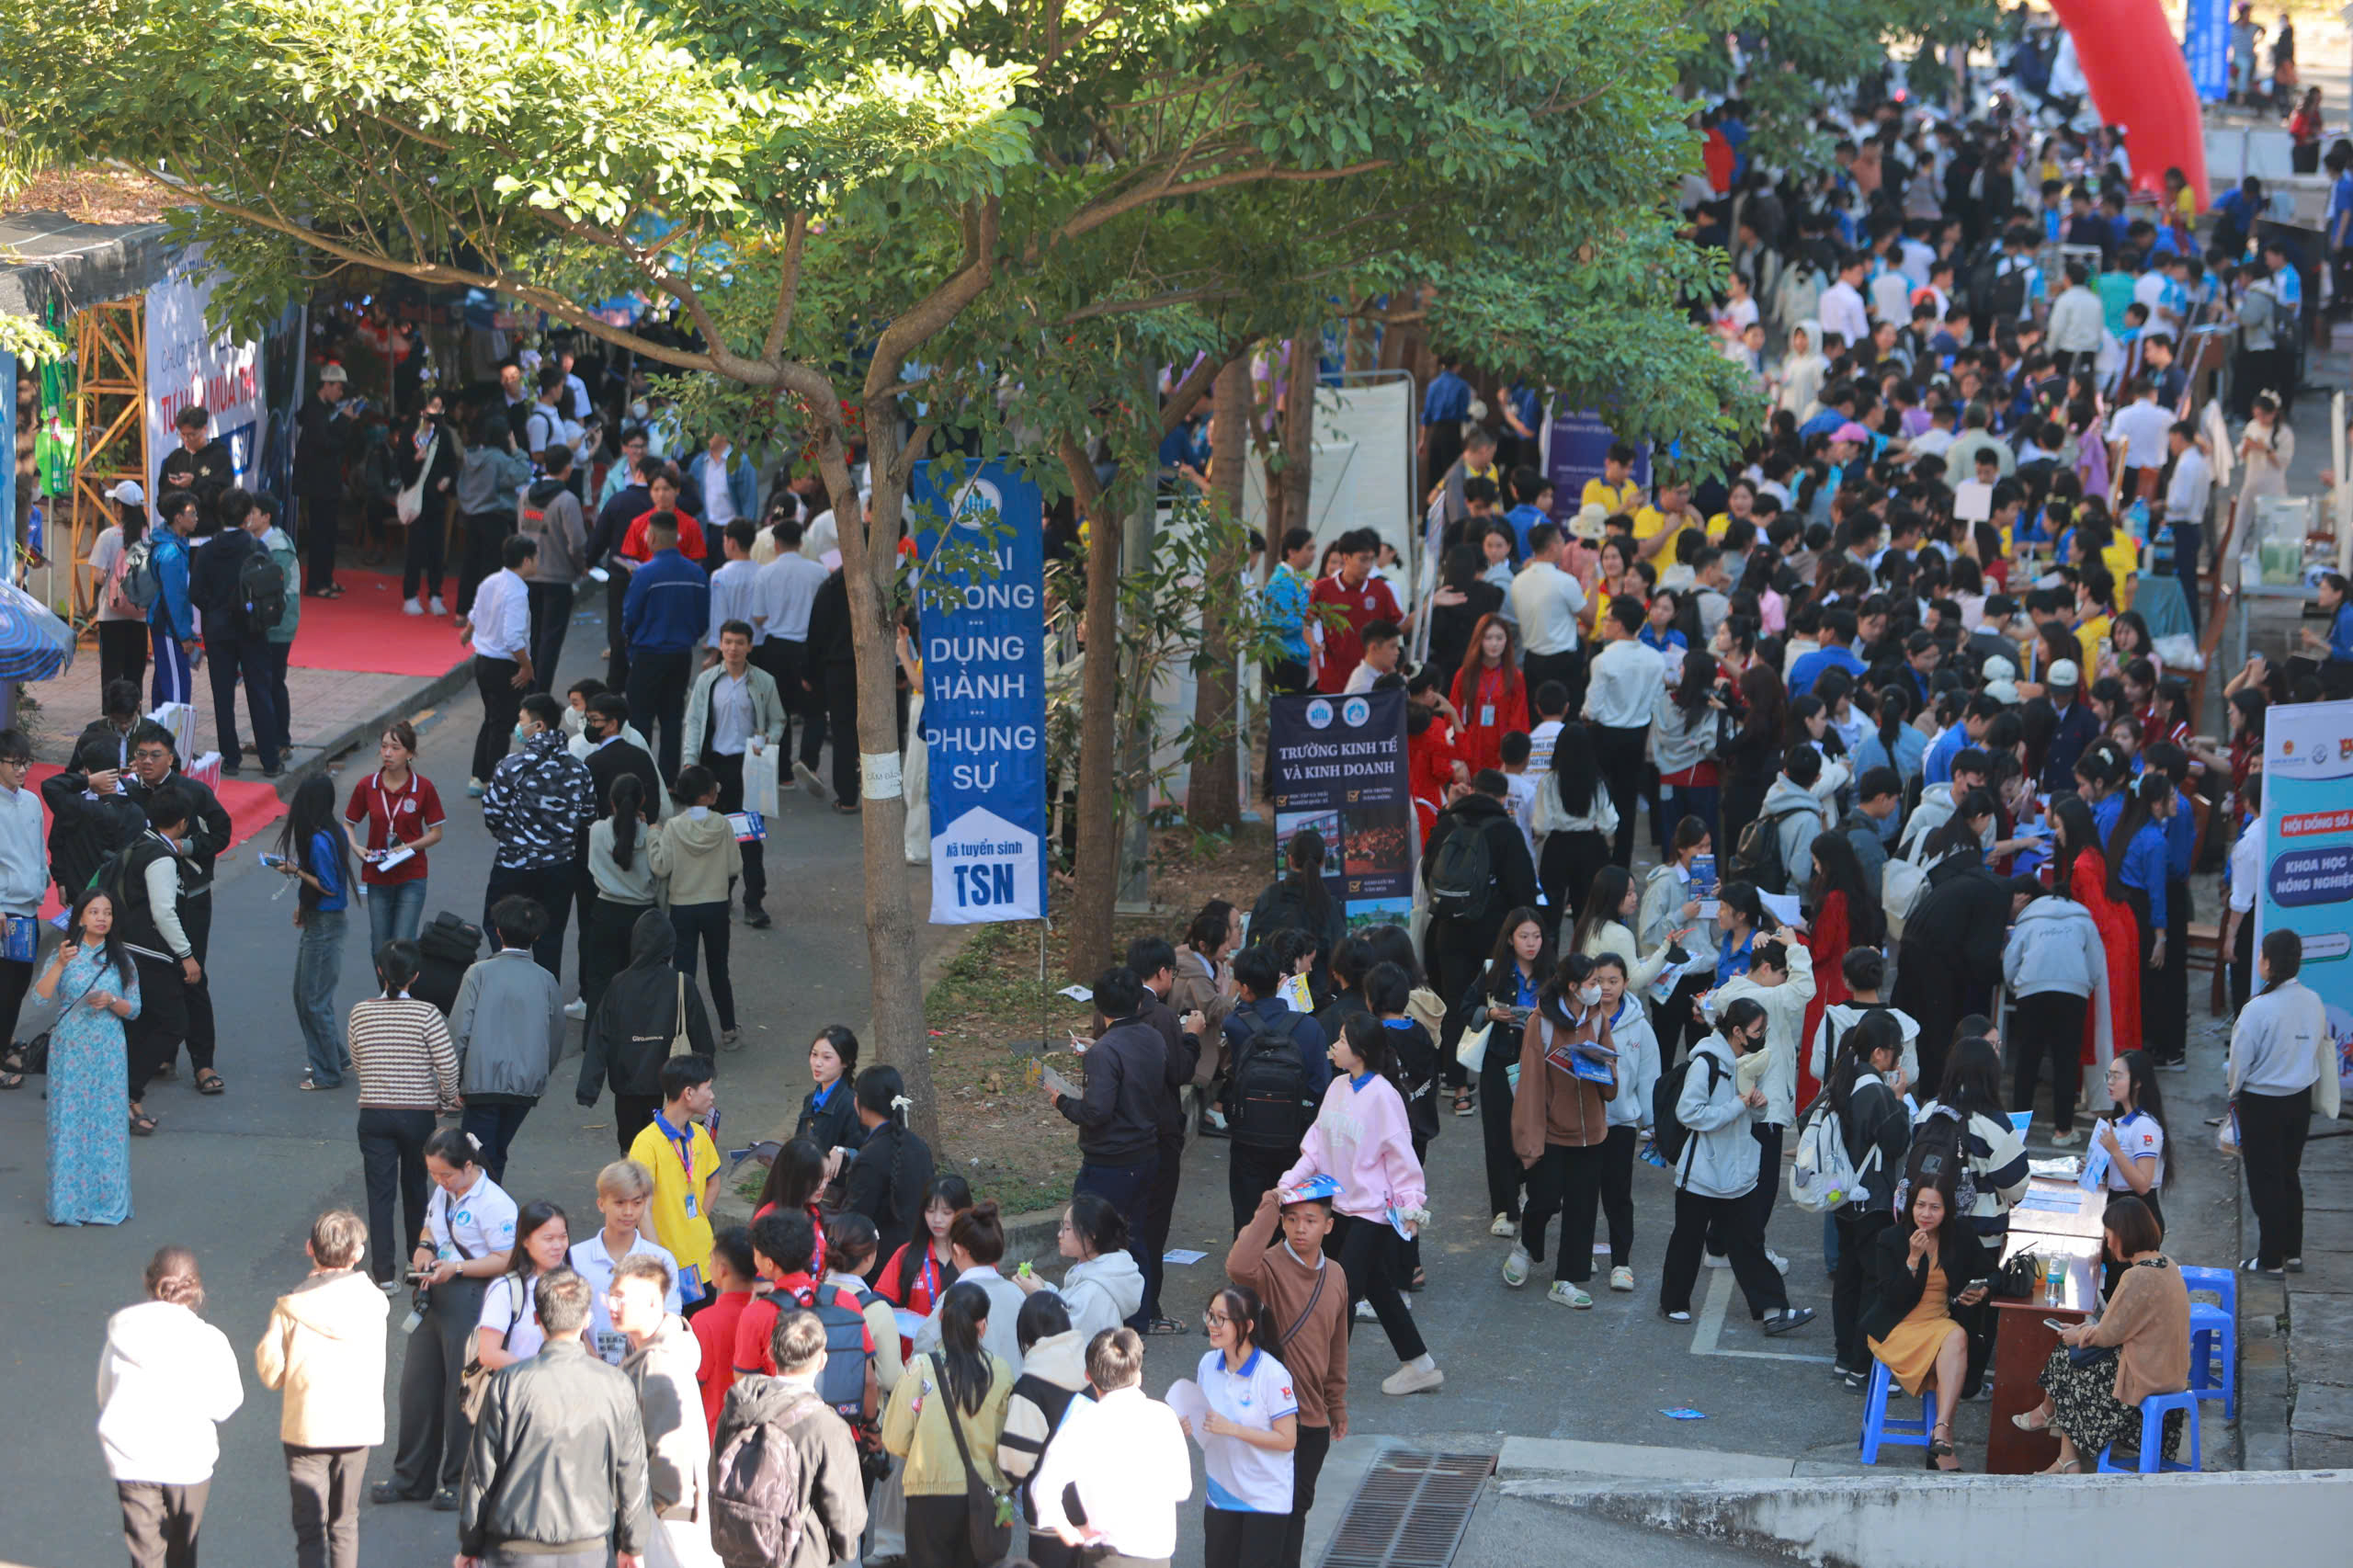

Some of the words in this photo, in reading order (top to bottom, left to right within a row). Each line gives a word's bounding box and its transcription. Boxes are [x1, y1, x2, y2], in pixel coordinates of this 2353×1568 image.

[931, 635, 1025, 665] DỤNG
[933, 669, 1025, 700] HÀNH
[926, 725, 1036, 756] PHỤNG
[1279, 741, 1338, 760] TRƯỜNG
[1341, 741, 1377, 756] KINH
[1379, 734, 1397, 754] TẾ
[953, 760, 999, 793] SỰ
[1283, 764, 1302, 780] VÀ
[1304, 765, 1341, 779] KINH
[1344, 760, 1395, 777] DOANH
[961, 838, 994, 857] tuyển
[997, 841, 1022, 855] sinh
[2285, 858, 2319, 874] KHOA
[2322, 856, 2347, 871] HỌC
[954, 864, 1014, 907] TSN
[2276, 877, 2311, 893] NÔNG
